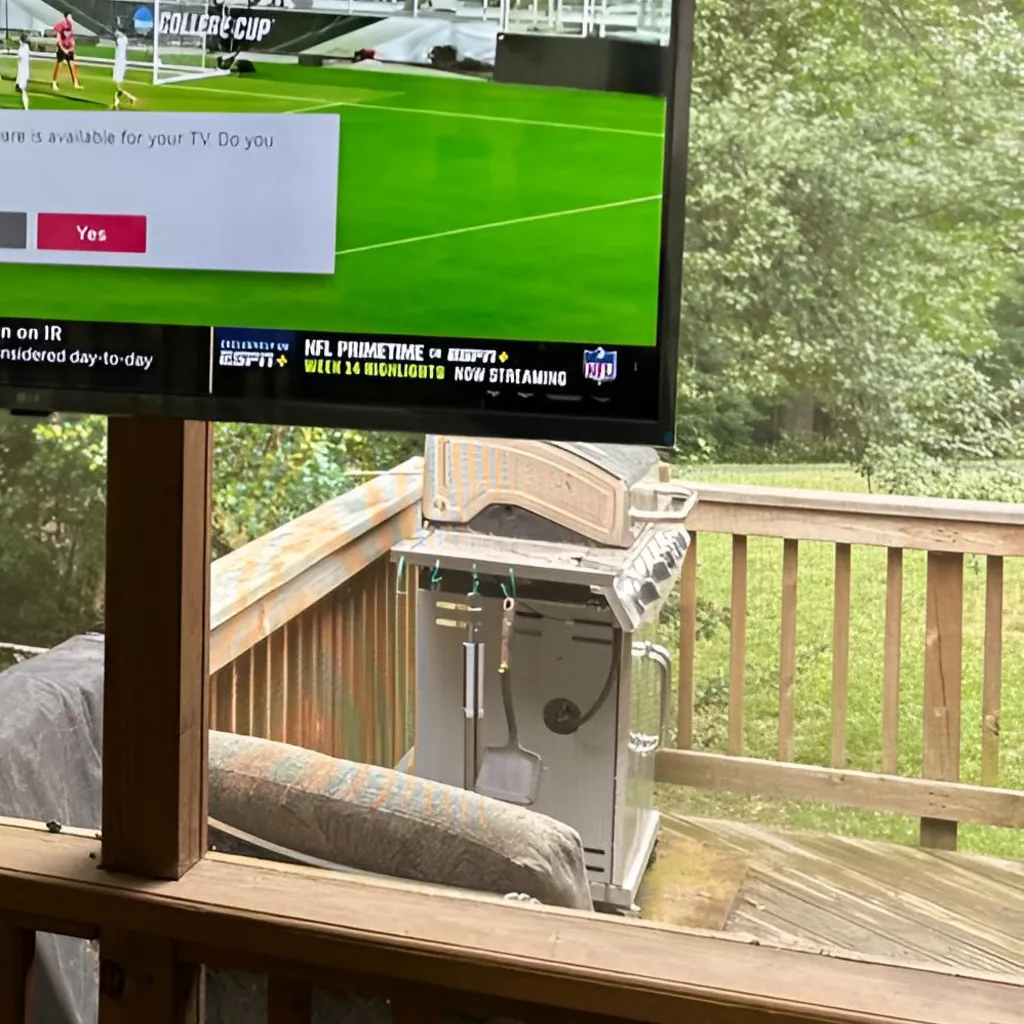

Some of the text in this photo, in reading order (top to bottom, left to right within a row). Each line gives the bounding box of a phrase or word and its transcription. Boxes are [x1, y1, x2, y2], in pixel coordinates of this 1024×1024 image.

[233, 17, 271, 41] CUP
[31, 129, 43, 144] is
[48, 129, 115, 144] available
[121, 129, 143, 146] for
[148, 133, 184, 148] your
[218, 131, 240, 147] Do
[244, 134, 274, 150] you
[76, 225, 107, 241] Yes
[17, 326, 39, 340] on
[44, 325, 62, 341] IR
[70, 349, 154, 370] day-to-day
[305, 339, 333, 357] NFL
[337, 340, 425, 362] PRIMETIME
[454, 366, 485, 383] NOW
[489, 368, 567, 387] STREAMING
